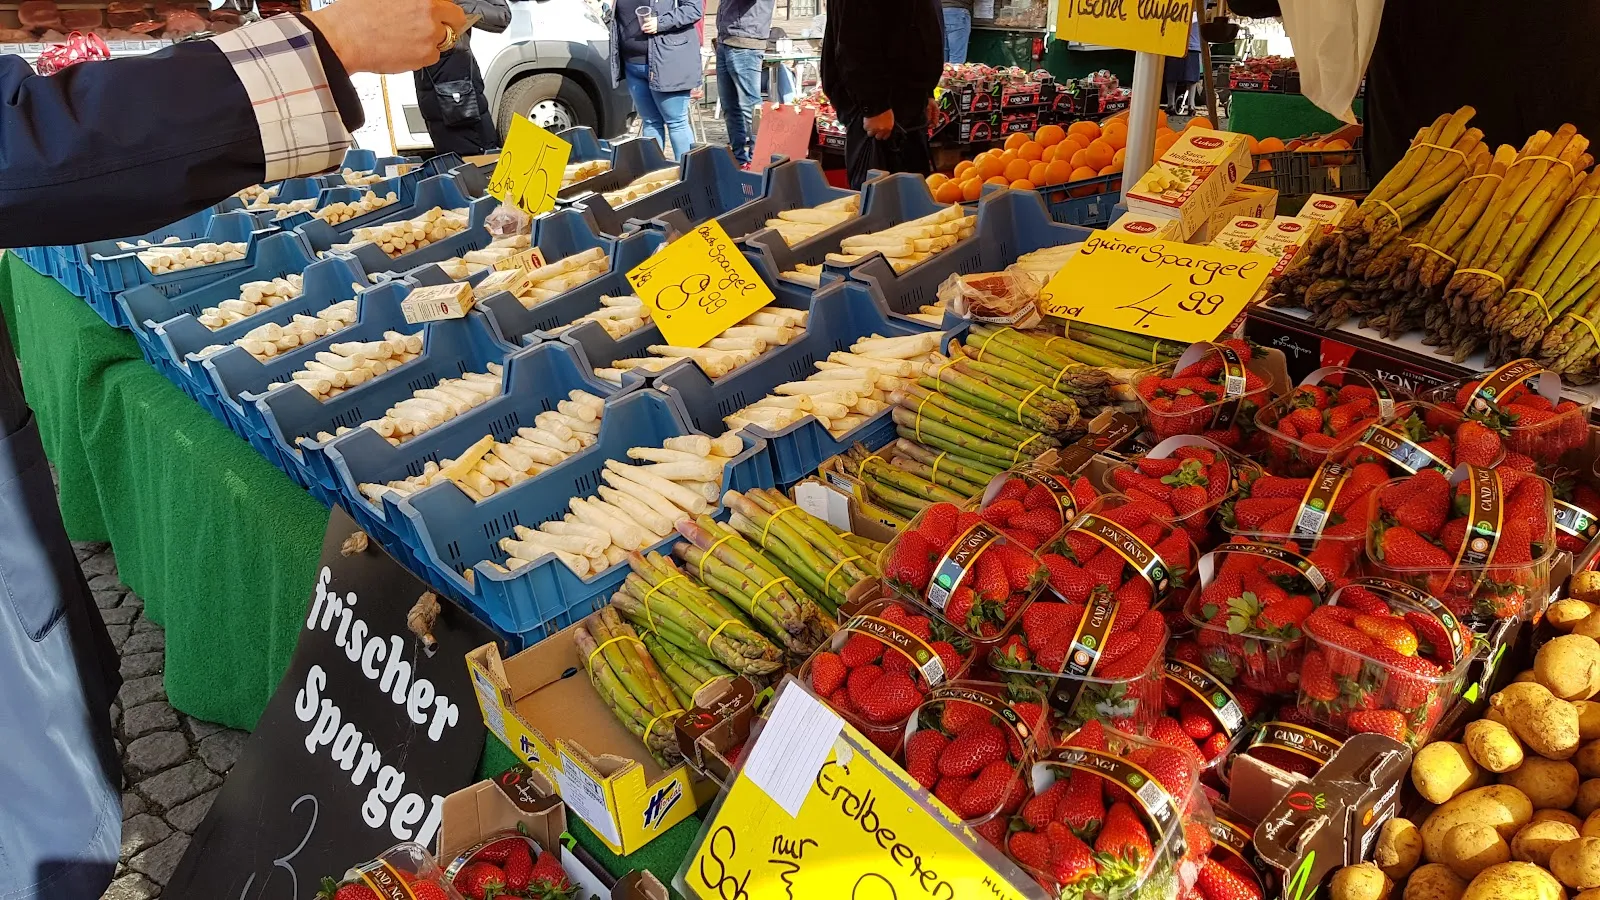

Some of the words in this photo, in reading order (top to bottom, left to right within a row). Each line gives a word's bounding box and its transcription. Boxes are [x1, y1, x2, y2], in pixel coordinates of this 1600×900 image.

[1193, 137, 1221, 148] Lukull
[1169, 153, 1211, 165] Hollandaise
[1183, 151, 1206, 159] Sauce
[1314, 201, 1336, 210] Lukull
[1127, 223, 1154, 231] Lukull
[1236, 221, 1258, 229] Lukull
[1279, 222, 1301, 231] Lukull
[1141, 245, 1259, 286] Spargel
[1177, 291, 1225, 316] 99
[306, 565, 460, 742] frischer
[294, 664, 446, 856] Spargel
[815, 759, 955, 900] Erdbeeren
[772, 834, 819, 859] nur
